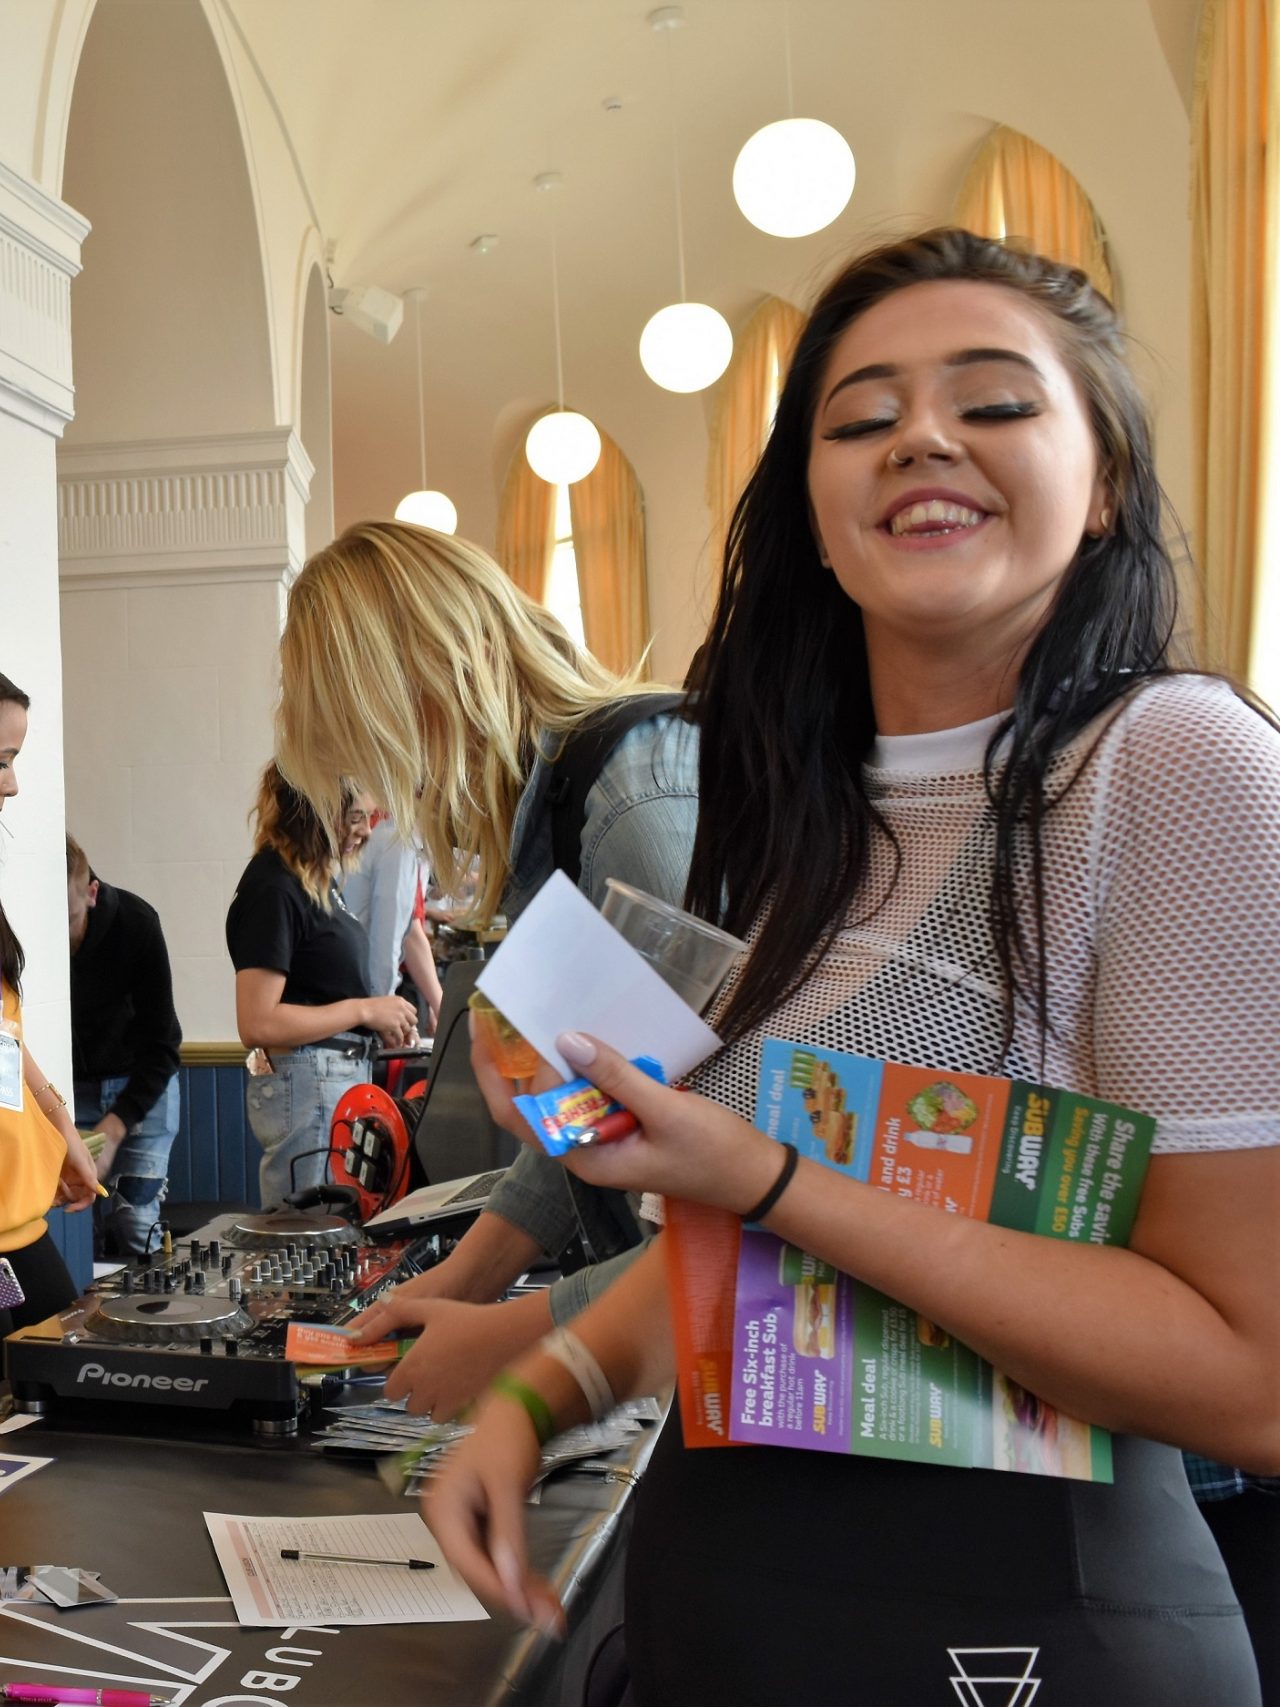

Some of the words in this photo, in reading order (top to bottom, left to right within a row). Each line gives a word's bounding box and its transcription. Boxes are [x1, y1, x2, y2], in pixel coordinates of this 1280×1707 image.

[769, 1069, 785, 1101] deal
[883, 1117, 901, 1154] drink
[1014, 1092, 1051, 1191] SUBWAY
[1088, 1113, 1108, 1142] With
[1081, 1144, 1100, 1175] these
[1107, 1119, 1136, 1169] Share
[880, 1156, 895, 1184] and
[896, 1166, 912, 1184] £3
[1062, 1148, 1078, 1173] you
[1057, 1175, 1070, 1203] over
[1075, 1178, 1094, 1203] free
[1100, 1172, 1122, 1201] the
[1051, 1206, 1069, 1232] £50
[1069, 1205, 1087, 1238] Subs
[762, 1313, 777, 1345] Sub
[743, 1320, 760, 1384] Six-inch
[76, 1362, 209, 1394] Pioneer
[760, 1348, 776, 1427] breakfast
[779, 1354, 788, 1391] purchase
[788, 1377, 796, 1390] hot
[862, 1358, 876, 1393] deal
[778, 1394, 786, 1408] the
[796, 1378, 804, 1400] 11am
[812, 1369, 827, 1435] SUBWAY
[741, 1388, 756, 1425] Free
[777, 1410, 785, 1428] with
[787, 1392, 797, 1422] regular
[795, 1402, 804, 1430] before
[860, 1397, 876, 1438] Meal
[928, 1382, 943, 1447] SUBWAY
